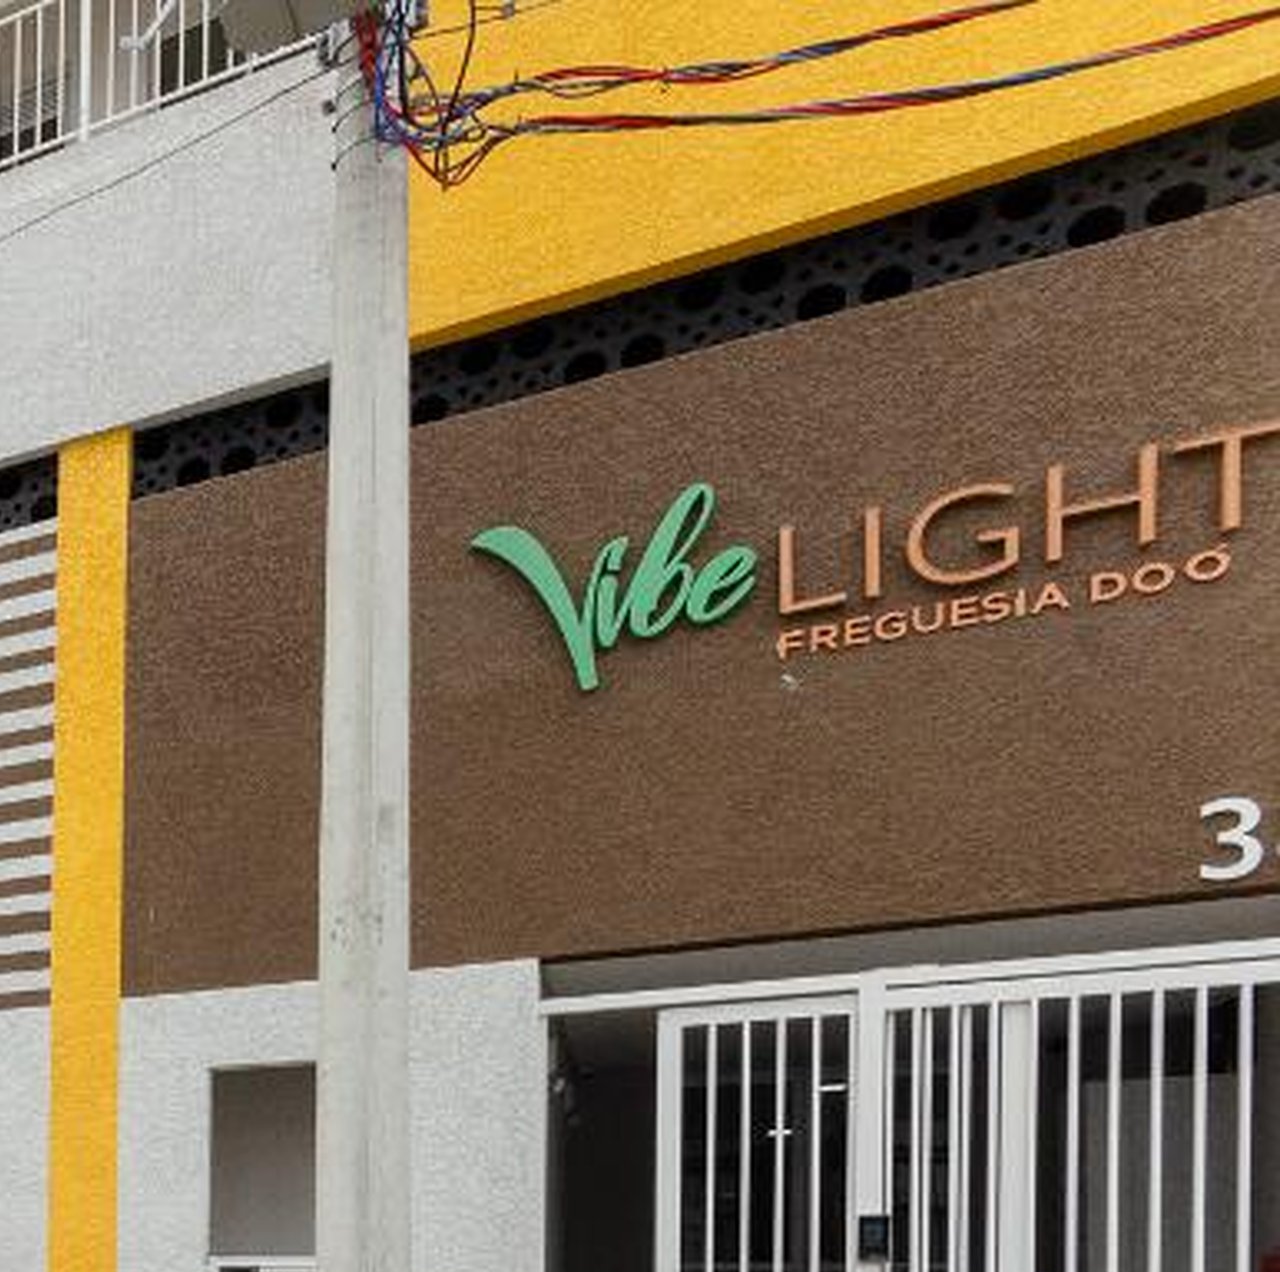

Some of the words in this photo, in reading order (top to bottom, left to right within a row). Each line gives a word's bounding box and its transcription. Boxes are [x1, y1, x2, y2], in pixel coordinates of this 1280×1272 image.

[471, 483, 757, 690] Vibe
[779, 420, 1280, 613] LIGHT
[776, 581, 1069, 658] FREGUESIA
